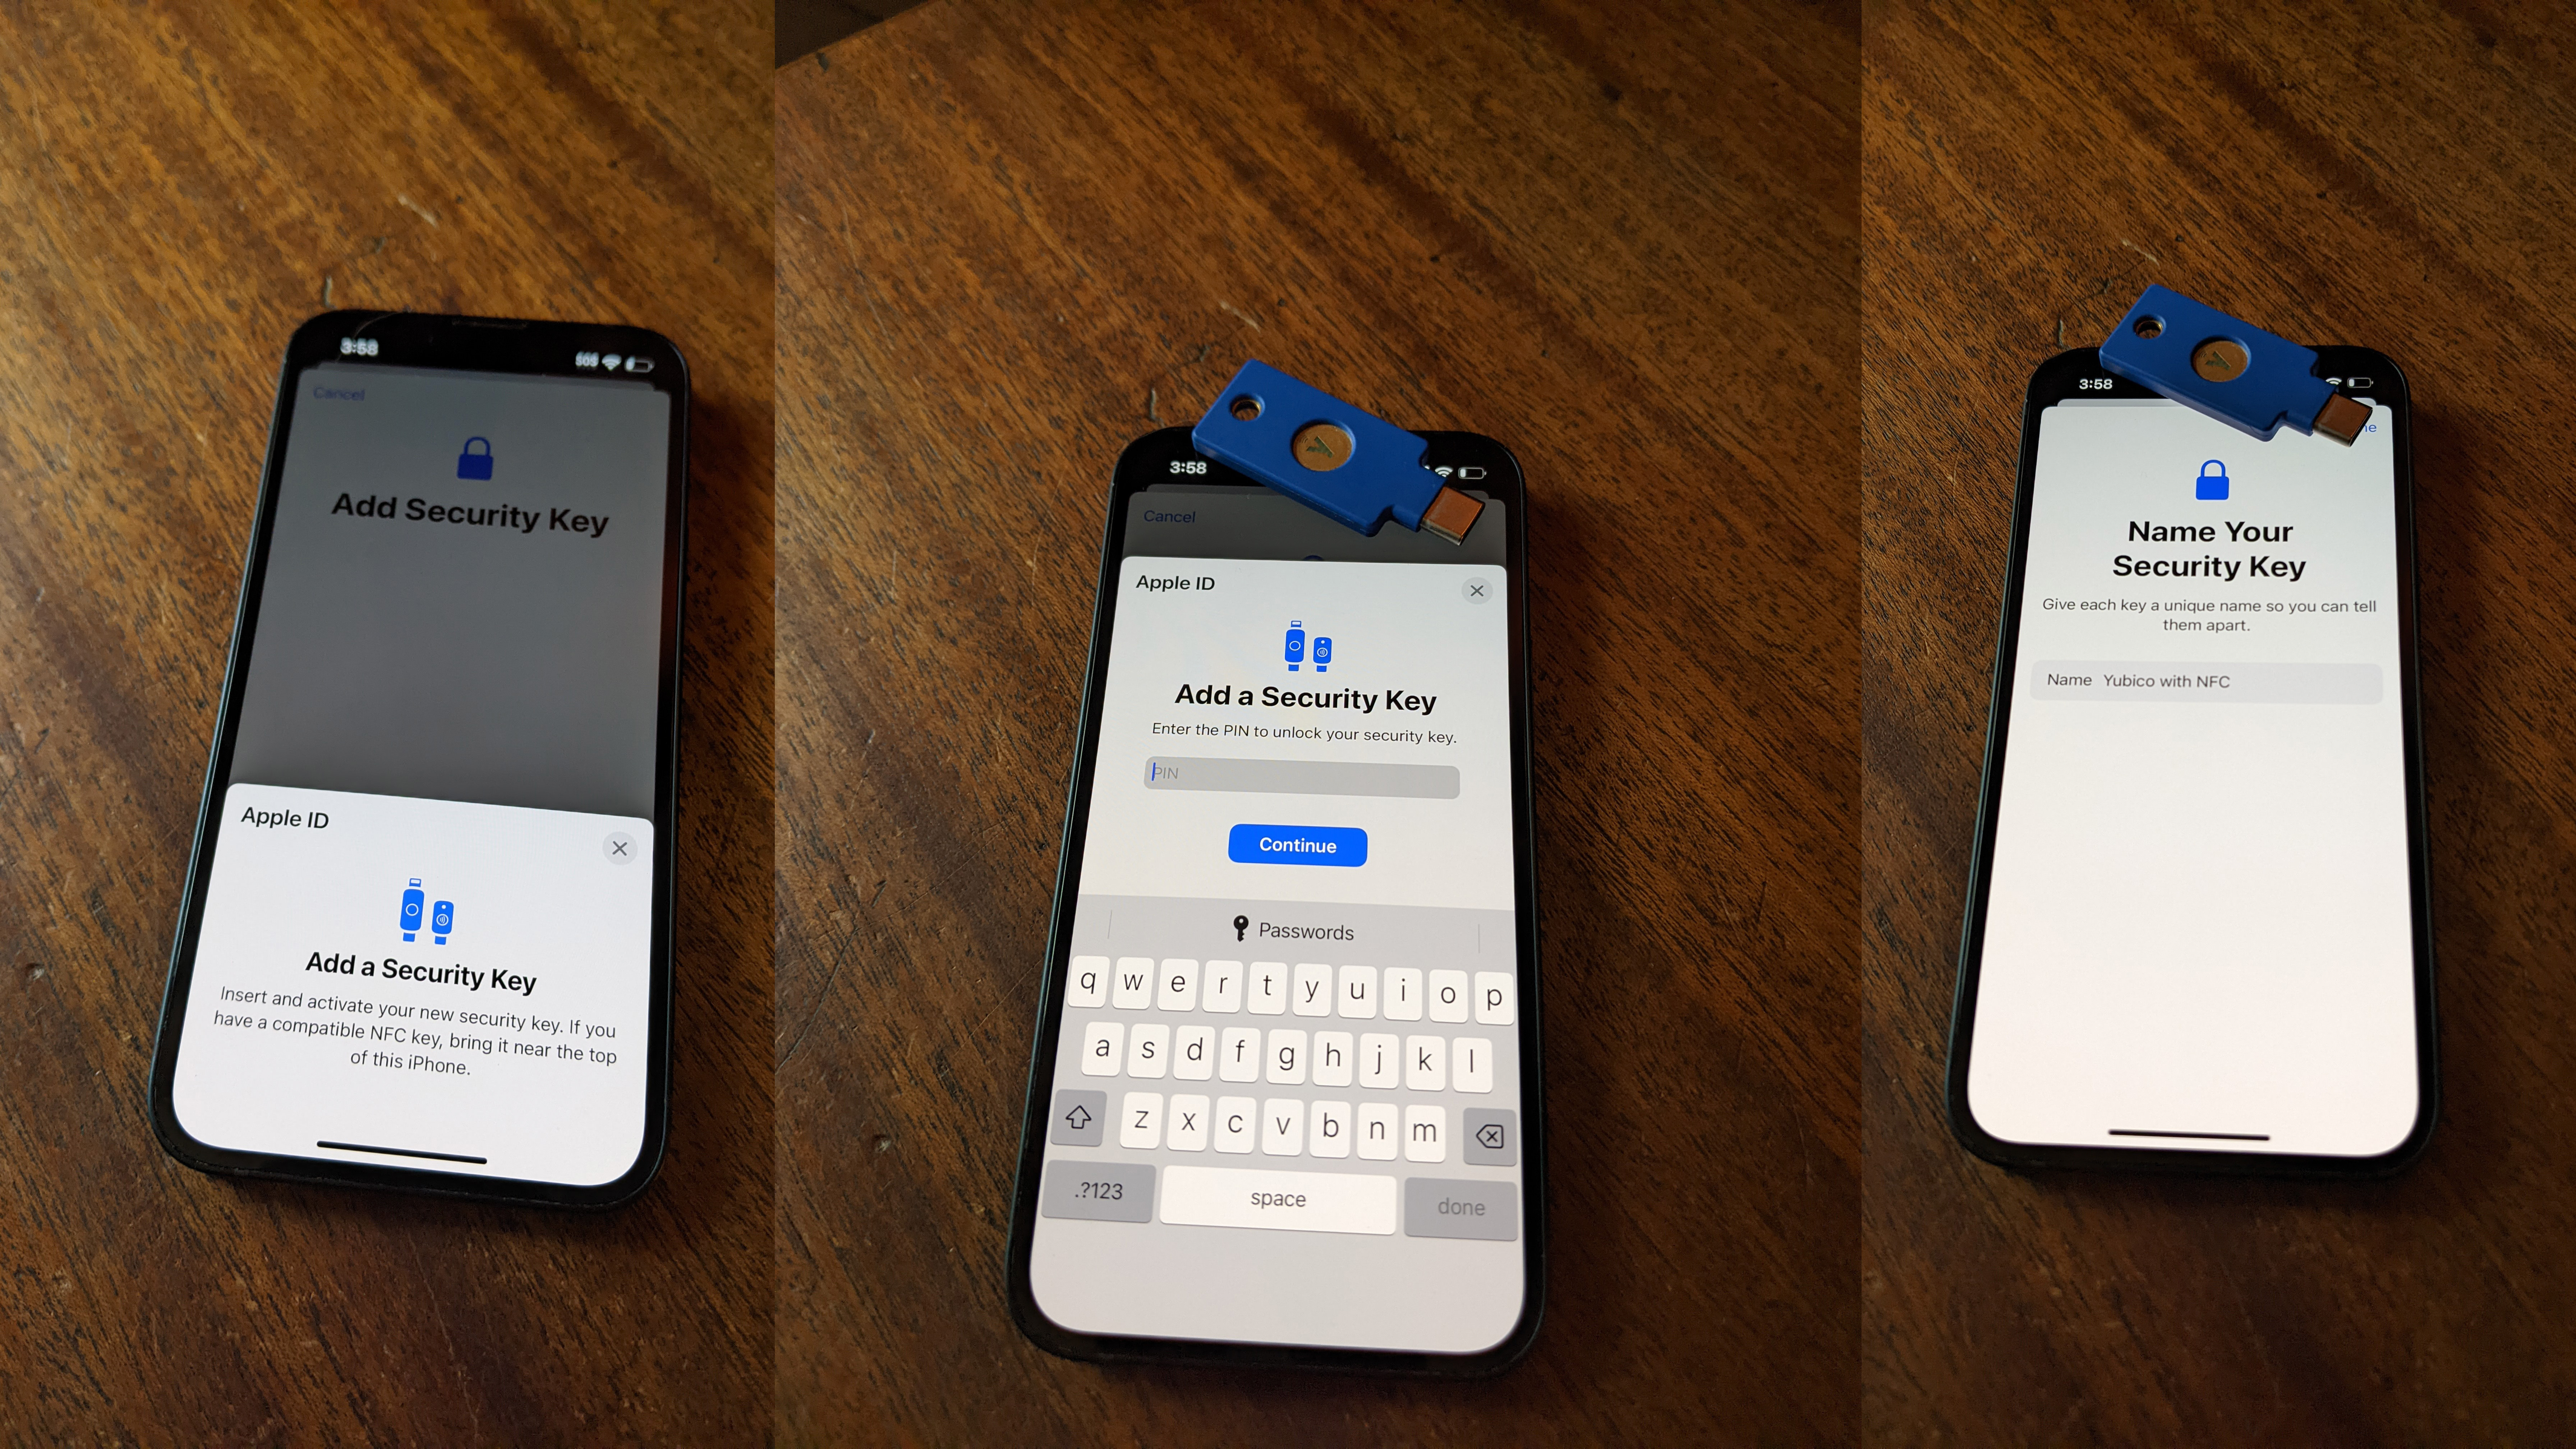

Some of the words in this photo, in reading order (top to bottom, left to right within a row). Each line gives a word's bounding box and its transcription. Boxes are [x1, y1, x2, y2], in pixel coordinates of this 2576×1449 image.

[340, 337, 379, 356] 3:58
[2079, 378, 2113, 390] 3:58
[312, 386, 366, 402] Cancel
[1169, 461, 1207, 475] 3:58
[331, 493, 398, 519] Add
[404, 497, 541, 534] Security
[549, 507, 610, 539] Key
[1144, 510, 1196, 524] Cancel
[2128, 521, 2216, 542] Name
[2224, 521, 2294, 542] Your
[2112, 555, 2242, 582] Security
[2250, 556, 2306, 582] Key
[1135, 575, 1191, 593] Apple
[1196, 576, 1215, 590] ID
[2042, 598, 2076, 611] Give
[2080, 598, 2116, 611] each
[2121, 598, 2147, 614] key
[2150, 602, 2159, 611] a
[2164, 599, 2215, 614] unique
[2220, 602, 2262, 612] name
[2266, 602, 2284, 612] so
[2288, 603, 2316, 615] you
[2320, 603, 2349, 613] can
[2353, 600, 2377, 613] tell
[2163, 618, 2202, 631] them
[2206, 620, 2250, 634] apart.
[2047, 673, 2093, 686] Name
[2103, 674, 2156, 687] Yubico
[2159, 674, 2192, 688] with
[2196, 675, 2230, 689] NFC
[1174, 684, 1231, 705] Add
[1238, 690, 1254, 706] a
[1261, 686, 1379, 714] Security
[1386, 690, 1438, 716] Key
[1152, 722, 1192, 735] Enter
[1195, 723, 1219, 736] the
[1224, 724, 1250, 737] PIN
[1254, 726, 1269, 738] to
[1273, 726, 1322, 739] unlock
[1326, 730, 1360, 742] your
[1363, 730, 1423, 745] security
[1428, 730, 1457, 746] key.
[240, 806, 302, 829] Apple
[307, 811, 329, 829] ID
[1259, 837, 1337, 854] Continue
[1259, 922, 1354, 941] Passwords
[305, 951, 356, 975] Add
[361, 961, 375, 977] a
[382, 958, 485, 992] Security
[491, 968, 537, 997] Key
[1080, 972, 1096, 995] q
[1123, 974, 1144, 991] w
[1171, 975, 1186, 993] e
[1219, 977, 1228, 994] r
[1263, 975, 1272, 996] t
[1305, 980, 1319, 1003] y
[1350, 982, 1365, 1000] u
[1440, 986, 1456, 1004] o
[1487, 989, 1503, 1011] p
[221, 986, 268, 1004] Insert
[272, 992, 303, 1007] and
[307, 995, 373, 1014] activate
[378, 1004, 416, 1018] your
[420, 1008, 455, 1022] new
[459, 1012, 526, 1032] security
[532, 1015, 564, 1036] key.
[570, 1019, 581, 1035] If
[585, 1024, 616, 1039] you
[213, 1009, 253, 1028] have
[257, 1018, 267, 1030] a
[272, 1019, 365, 1039] compatible
[370, 1025, 406, 1043] NFC
[411, 1029, 443, 1050] key,
[450, 1032, 492, 1055] bring
[498, 1037, 509, 1053] it
[514, 1043, 552, 1057] near
[556, 1044, 584, 1061] the
[589, 1048, 617, 1067] top
[350, 1049, 369, 1065] of
[373, 1051, 403, 1069] this
[408, 1054, 470, 1076] iPhone.
[1095, 1039, 1110, 1057] a
[1141, 1041, 1155, 1059] s
[1187, 1037, 1203, 1061] d
[1235, 1039, 1245, 1063] f
[1279, 1046, 1295, 1071] g
[1326, 1042, 1341, 1067] h
[1419, 1046, 1432, 1071] k
[1134, 1110, 1149, 1129] z
[1181, 1112, 1196, 1131] x
[1228, 1114, 1243, 1133] c
[1276, 1117, 1291, 1135] v
[1323, 1112, 1339, 1138] b
[1370, 1121, 1385, 1140] n
[1413, 1123, 1436, 1142] m
[1075, 1181, 1123, 1200] .?123
[1251, 1192, 1307, 1209] space
[1438, 1197, 1486, 1216] done
